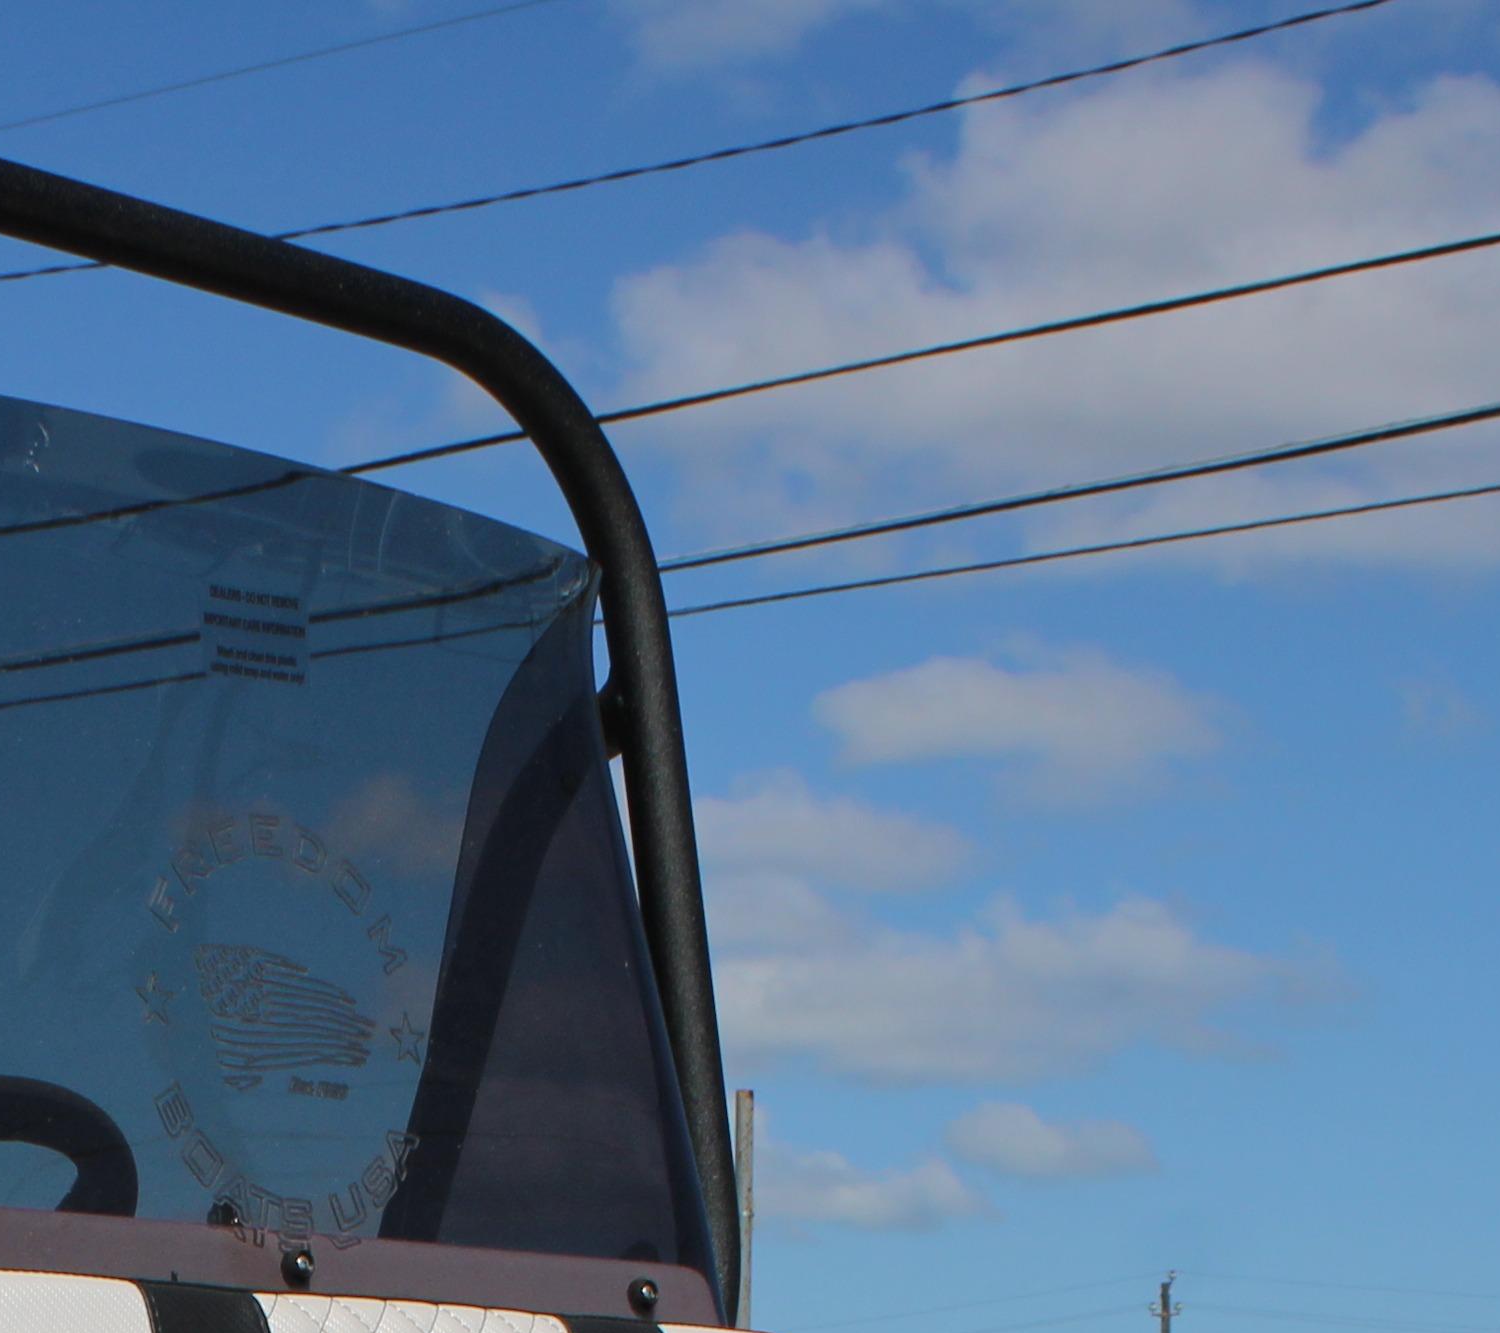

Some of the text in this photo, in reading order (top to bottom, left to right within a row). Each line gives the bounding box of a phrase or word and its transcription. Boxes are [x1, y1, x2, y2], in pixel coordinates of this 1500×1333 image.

[149, 814, 408, 975] FREEDOM
[154, 1080, 419, 1251] BOATS USA
